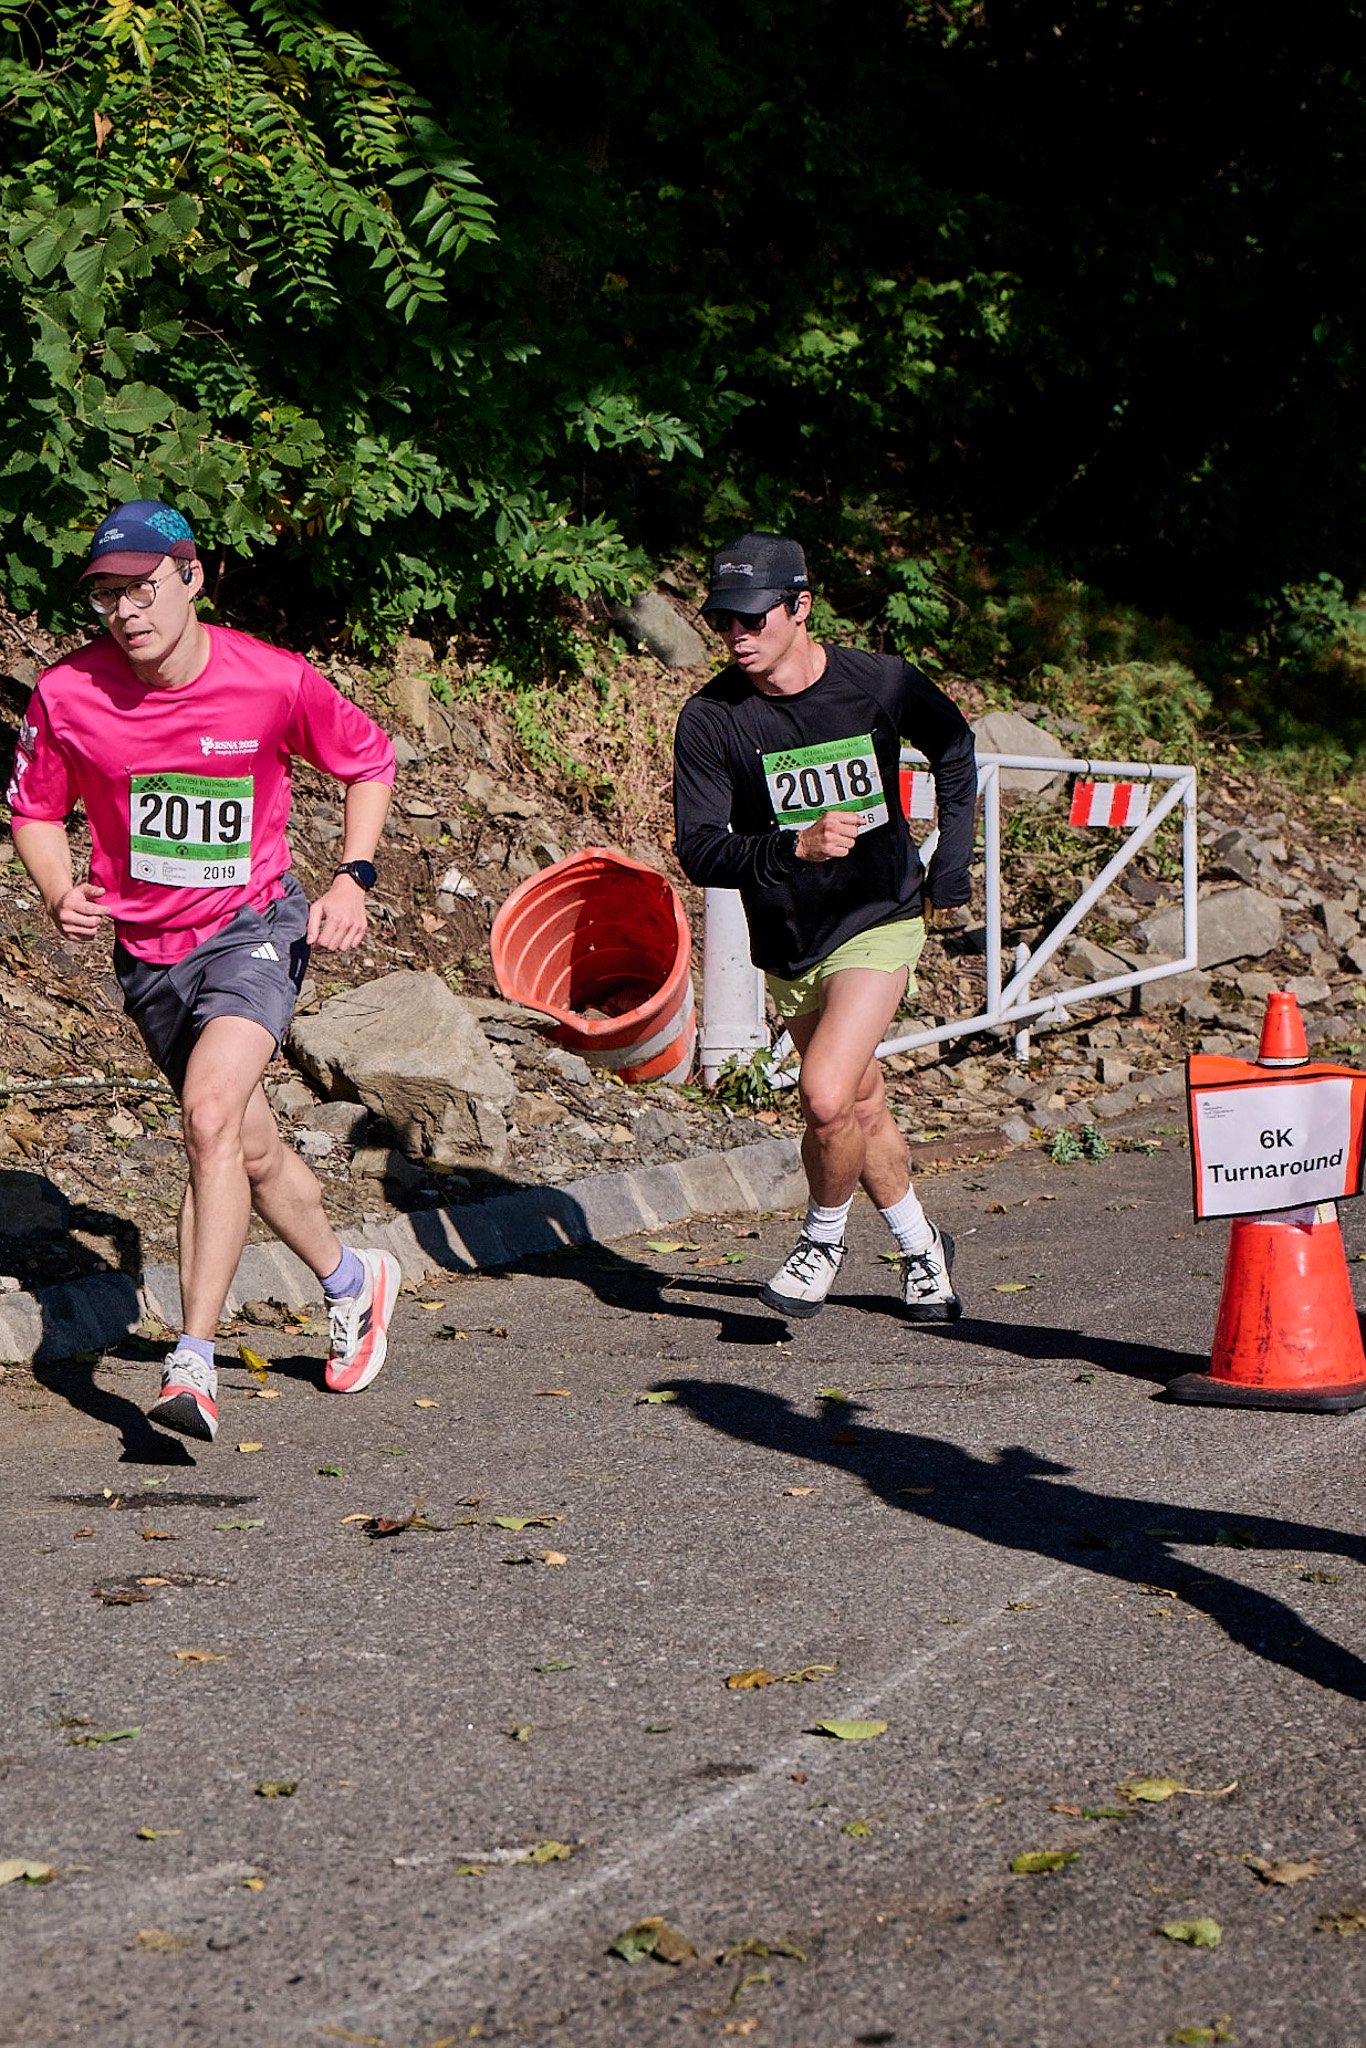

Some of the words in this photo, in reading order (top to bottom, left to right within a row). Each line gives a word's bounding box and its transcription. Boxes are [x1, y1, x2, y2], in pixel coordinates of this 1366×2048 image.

[776, 759, 872, 810] 2018
[139, 793, 242, 843] 2019
[203, 866, 236, 880] 2019
[1260, 1128, 1293, 1149] 6K
[1208, 1148, 1343, 1183] Turnaround
